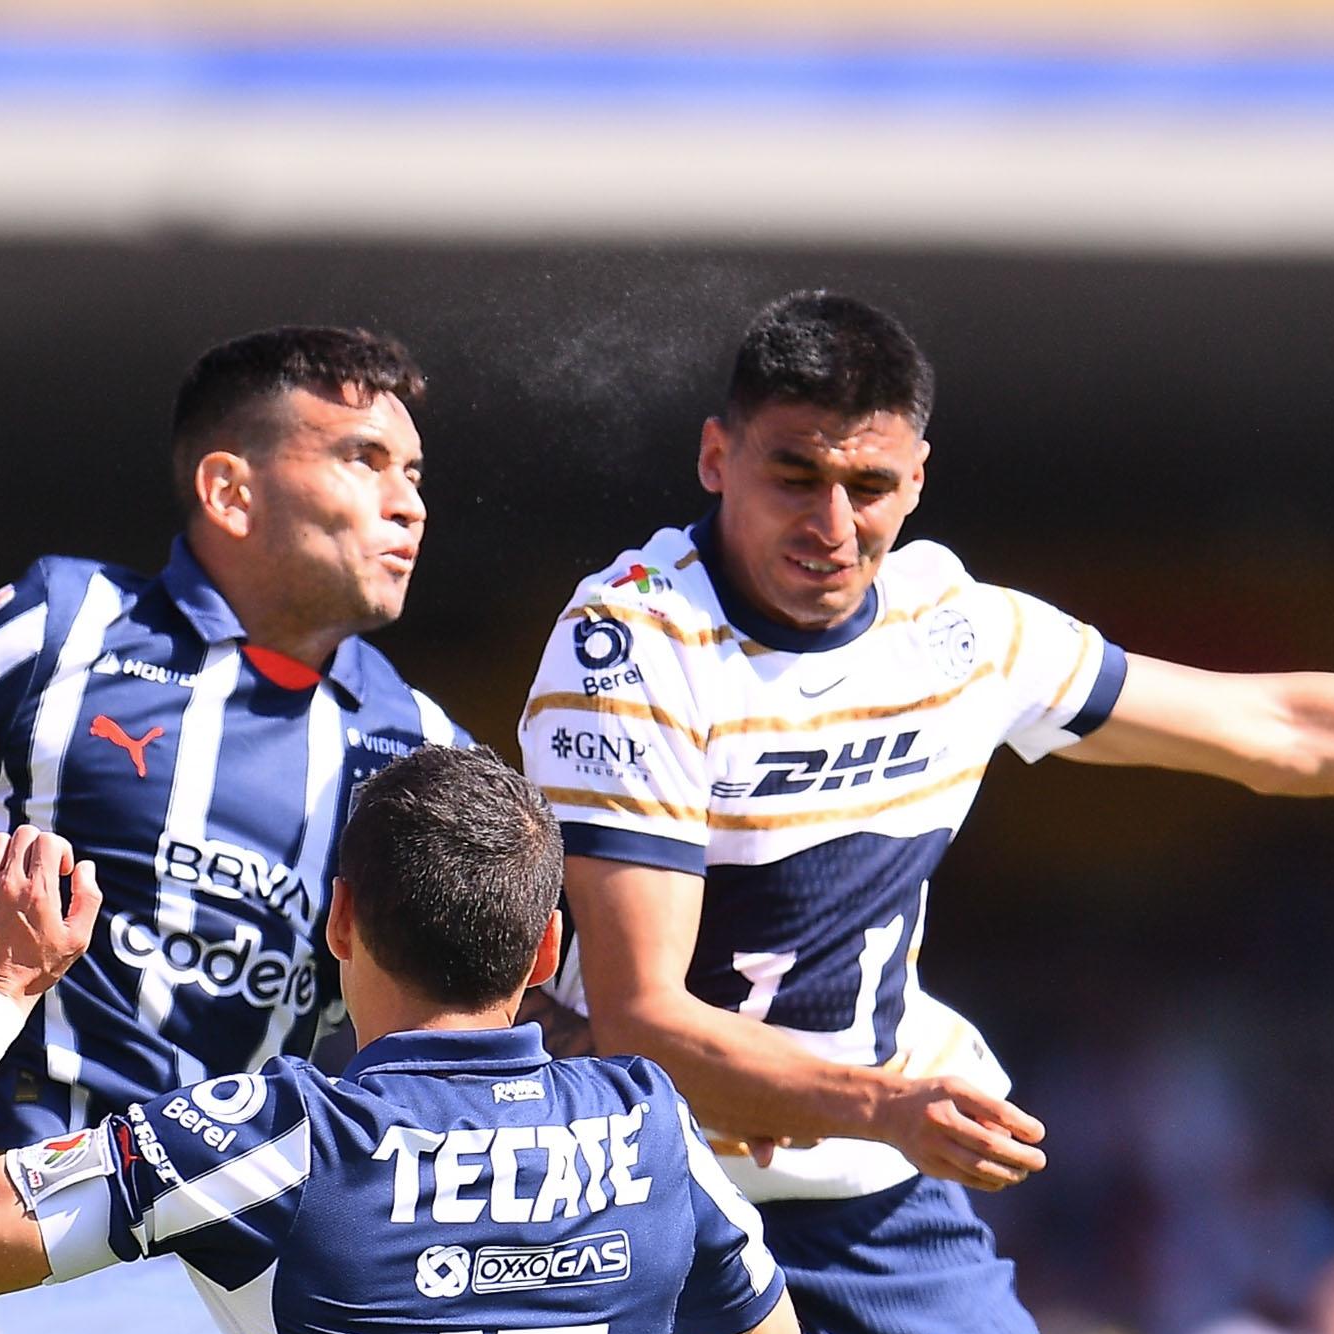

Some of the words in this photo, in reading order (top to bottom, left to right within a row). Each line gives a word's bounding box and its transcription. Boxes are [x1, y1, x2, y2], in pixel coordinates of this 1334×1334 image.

[582, 664, 645, 697] Berel
[575, 732, 646, 765] GNP
[749, 730, 929, 797] DHL
[163, 838, 311, 923] BBVA
[115, 911, 316, 1012] codere
[161, 1096, 237, 1153] Berel
[371, 1103, 653, 1224] TECATE
